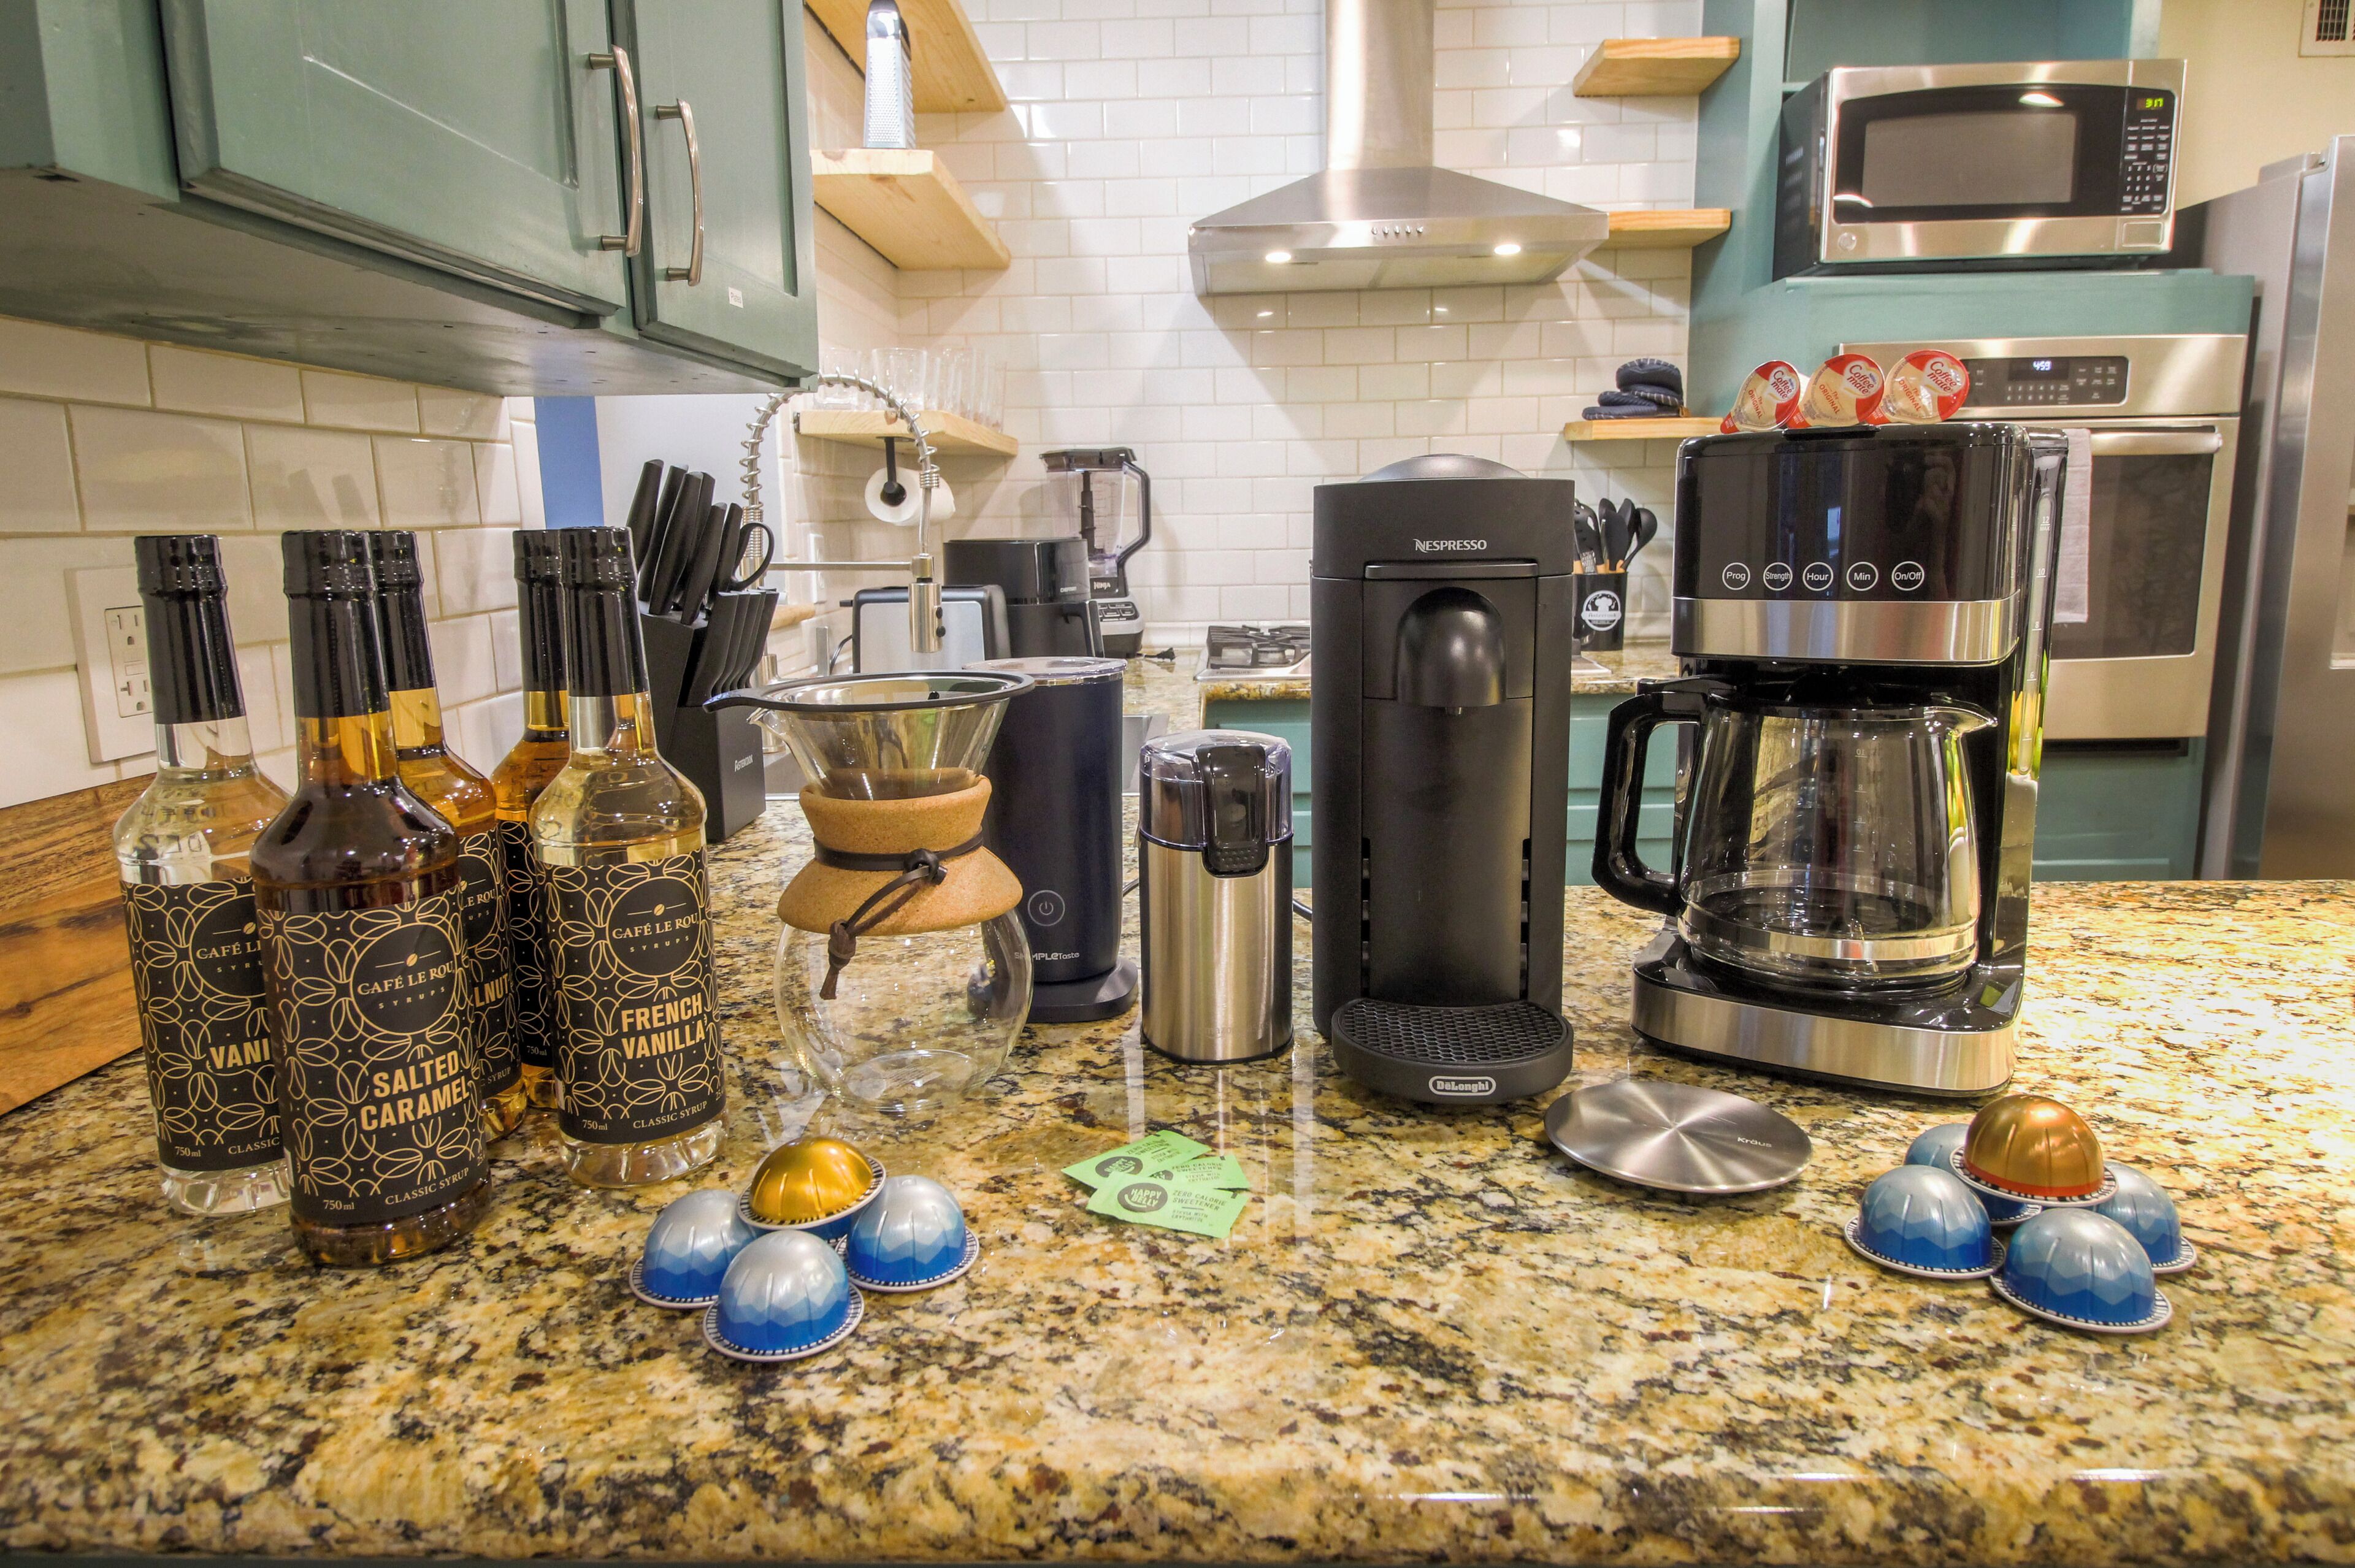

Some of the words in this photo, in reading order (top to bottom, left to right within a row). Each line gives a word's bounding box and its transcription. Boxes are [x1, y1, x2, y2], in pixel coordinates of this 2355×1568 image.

[1774, 370, 1792, 394] Coffee
[1849, 364, 1874, 389] Coffee
[1927, 372, 1951, 392] mate
[1931, 361, 1958, 387] Coffee
[1771, 381, 1788, 399] mate
[1847, 376, 1869, 394] mate
[1748, 389, 1763, 419] ORIGINAL
[1819, 384, 1840, 415] ORIGINAL
[1899, 379, 1921, 412] ORIGINAL
[1413, 538, 1487, 553] NESPRESSO
[1093, 581, 1111, 590] NINJA
[1726, 572, 1746, 581] Prog
[1766, 572, 1790, 582] Strength
[1854, 572, 1871, 581] Min
[1894, 572, 1922, 581] On/Off
[612, 923, 652, 939] CAFÉ
[655, 920, 673, 933] LE
[196, 942, 242, 959] CAFÉ
[630, 935, 689, 952] SYRUPS
[357, 974, 404, 995] CAFÉ
[407, 971, 427, 987] LE
[473, 972, 509, 1008] LNUT
[378, 986, 445, 1009] SYRUPS
[621, 992, 702, 1032] FRENCH
[621, 1019, 705, 1060] VANILLA
[209, 1038, 270, 1069] VANI
[372, 1050, 459, 1098] SALTED
[360, 1075, 470, 1131] CARAMEL
[633, 1112, 678, 1129] CLASSIC
[680, 1101, 707, 1119] SYRUP
[228, 1137, 280, 1154] CLASSIC
[385, 1184, 437, 1206] CLASSIC
[439, 1167, 470, 1189] SYRUP
[1131, 1188, 1162, 1199] HAPPY
[1131, 1195, 1158, 1207] BELLY
[1173, 1197, 1220, 1211] SWEETENER
[1195, 1193, 1227, 1206] CALORIE
